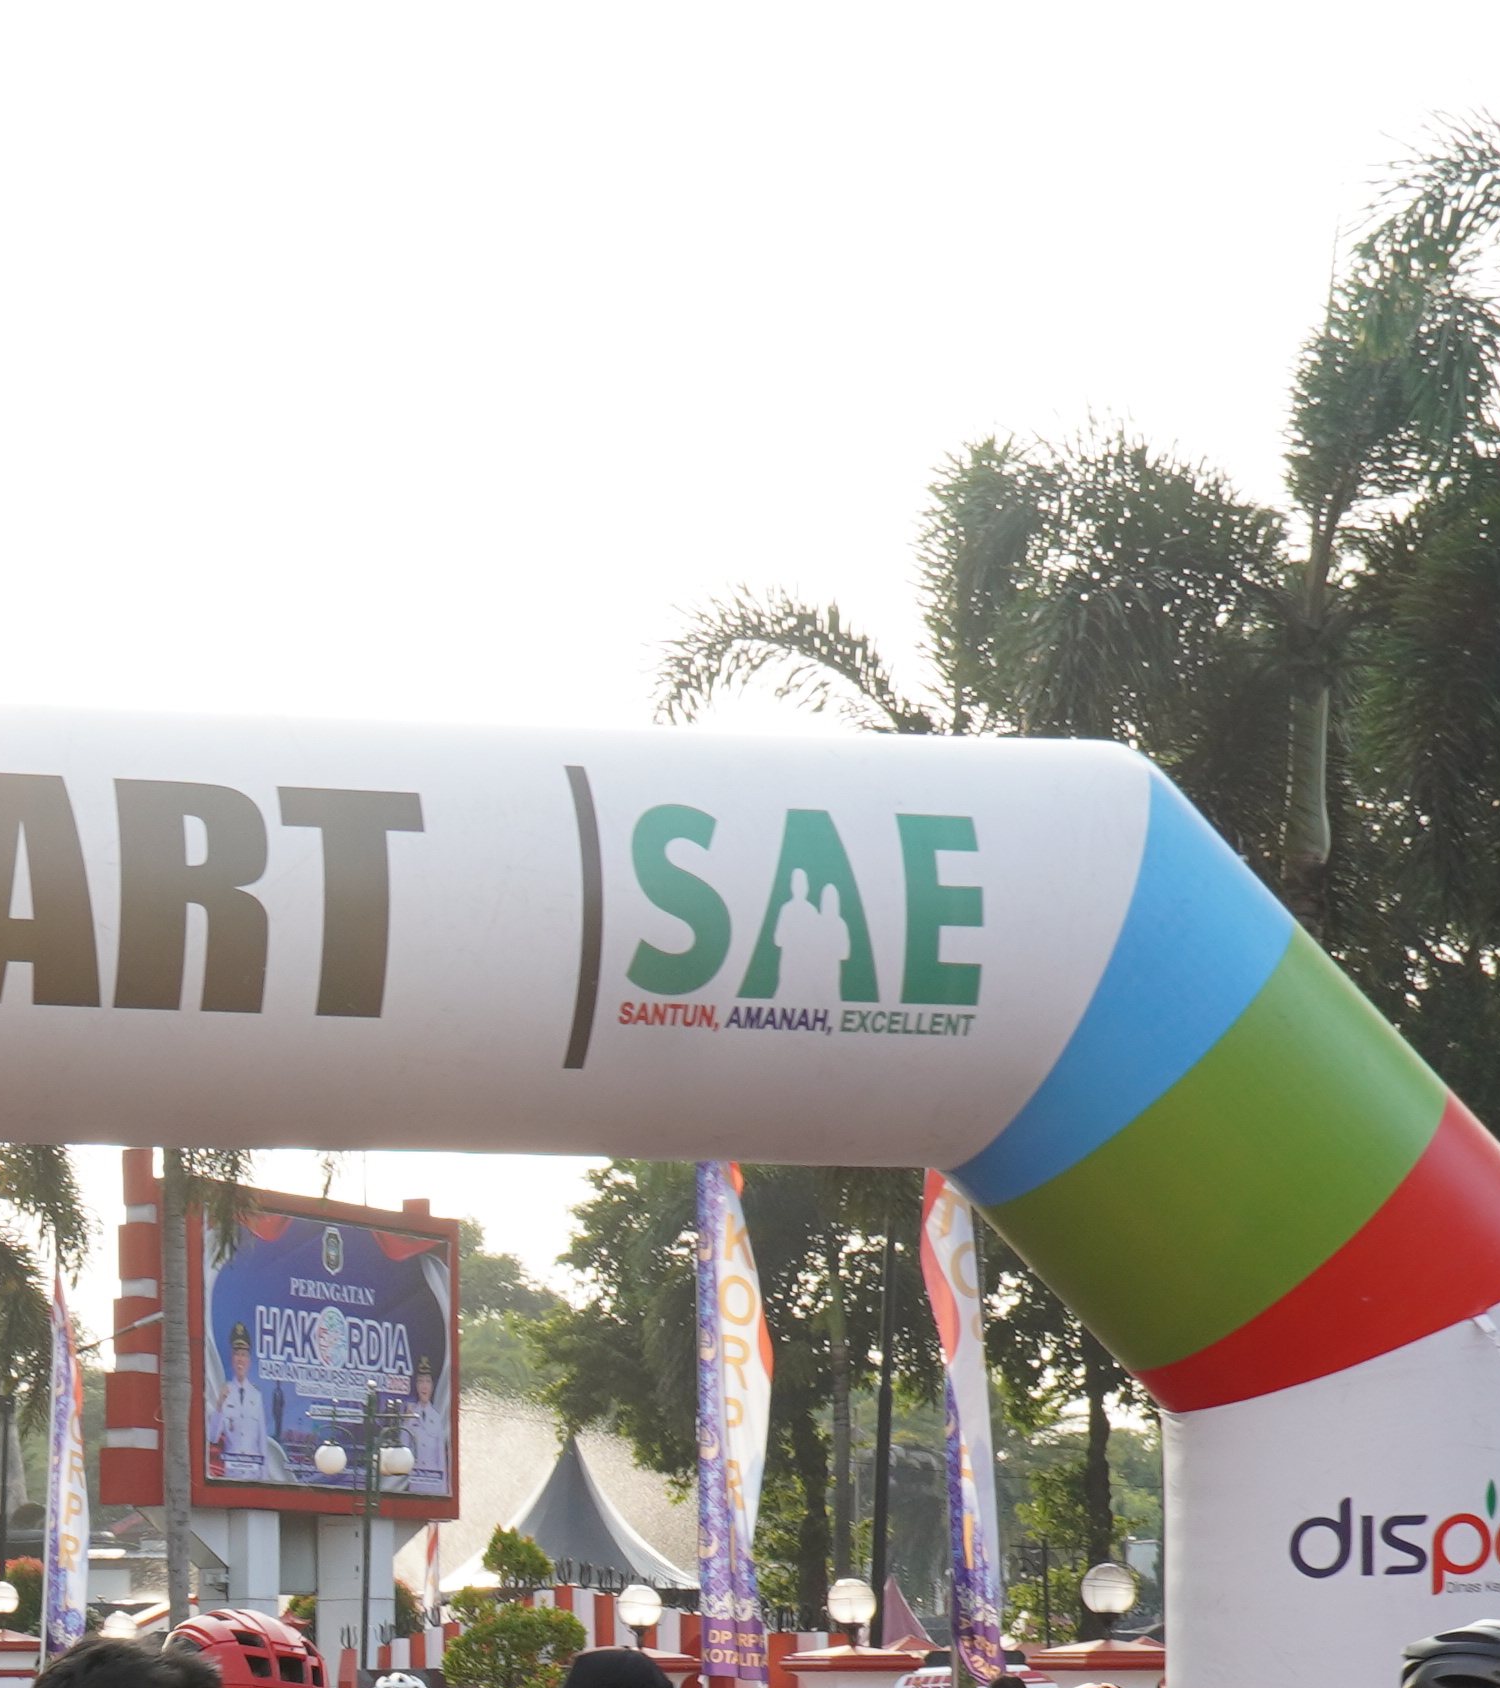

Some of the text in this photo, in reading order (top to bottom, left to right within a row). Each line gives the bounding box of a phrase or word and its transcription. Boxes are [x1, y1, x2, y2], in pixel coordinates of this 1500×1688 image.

[625, 804, 984, 1006] SAE
[618, 1002, 976, 1038] SANTUN, AMANAH, EXCELLENT
[289, 1277, 376, 1306] PERINGATAN
